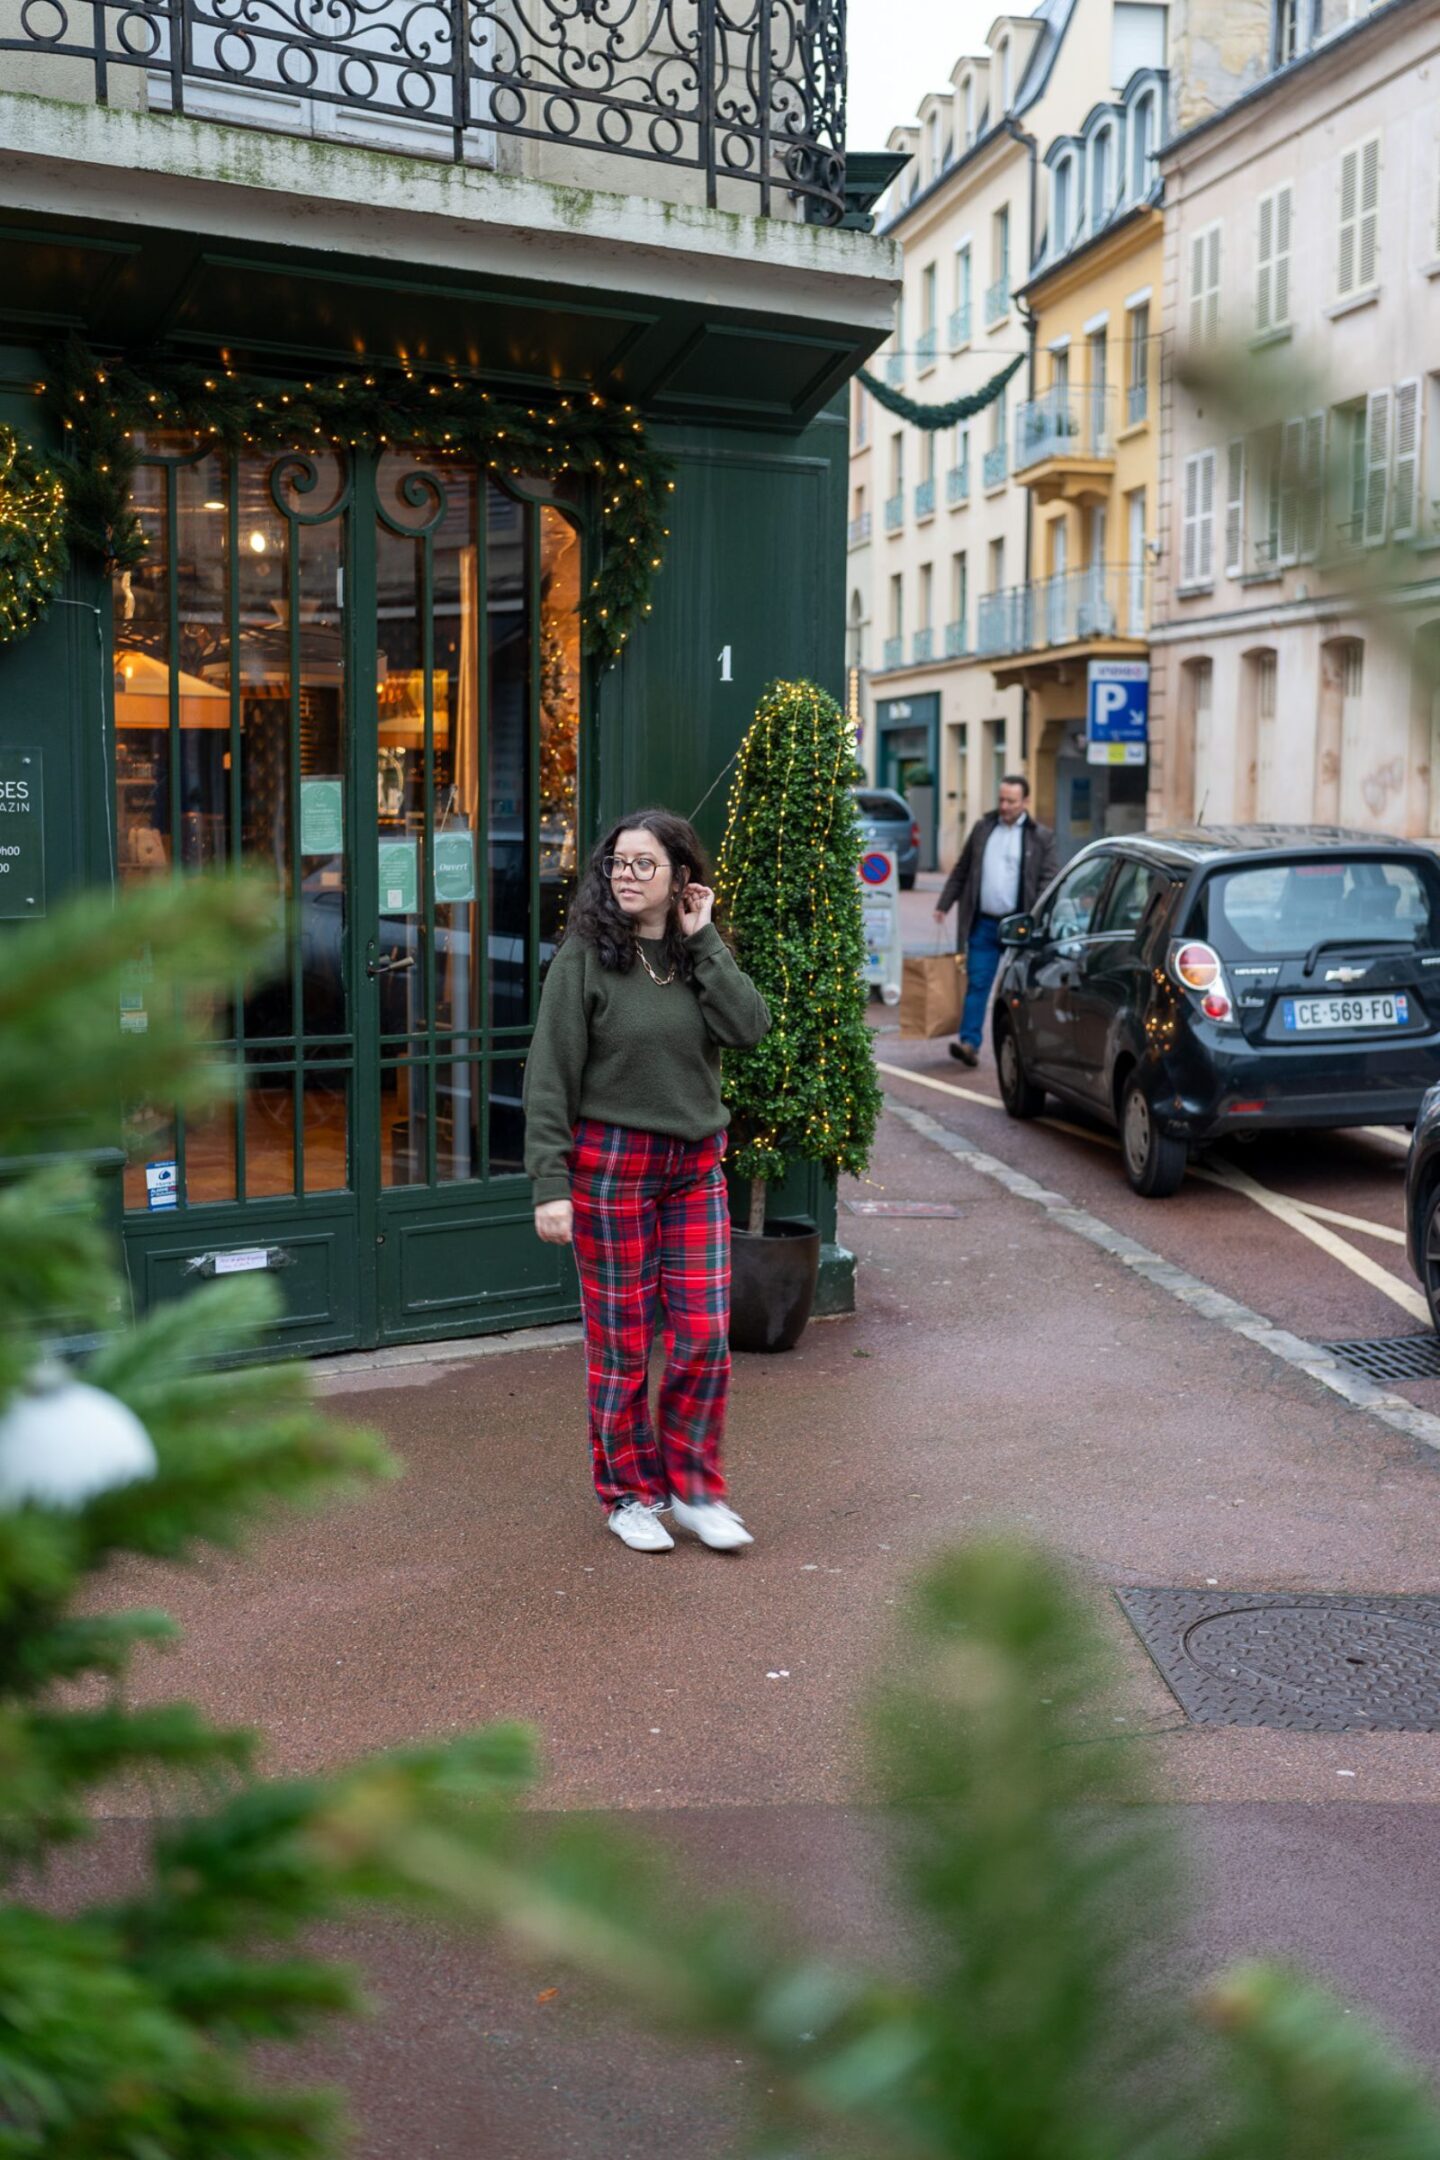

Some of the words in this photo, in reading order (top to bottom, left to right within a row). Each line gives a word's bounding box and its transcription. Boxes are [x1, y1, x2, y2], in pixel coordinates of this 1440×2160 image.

[717, 645, 733, 681] 1
[1095, 683, 1128, 725] P
[0, 846, 20, 856] h00
[439, 863, 467, 873] Ouvert
